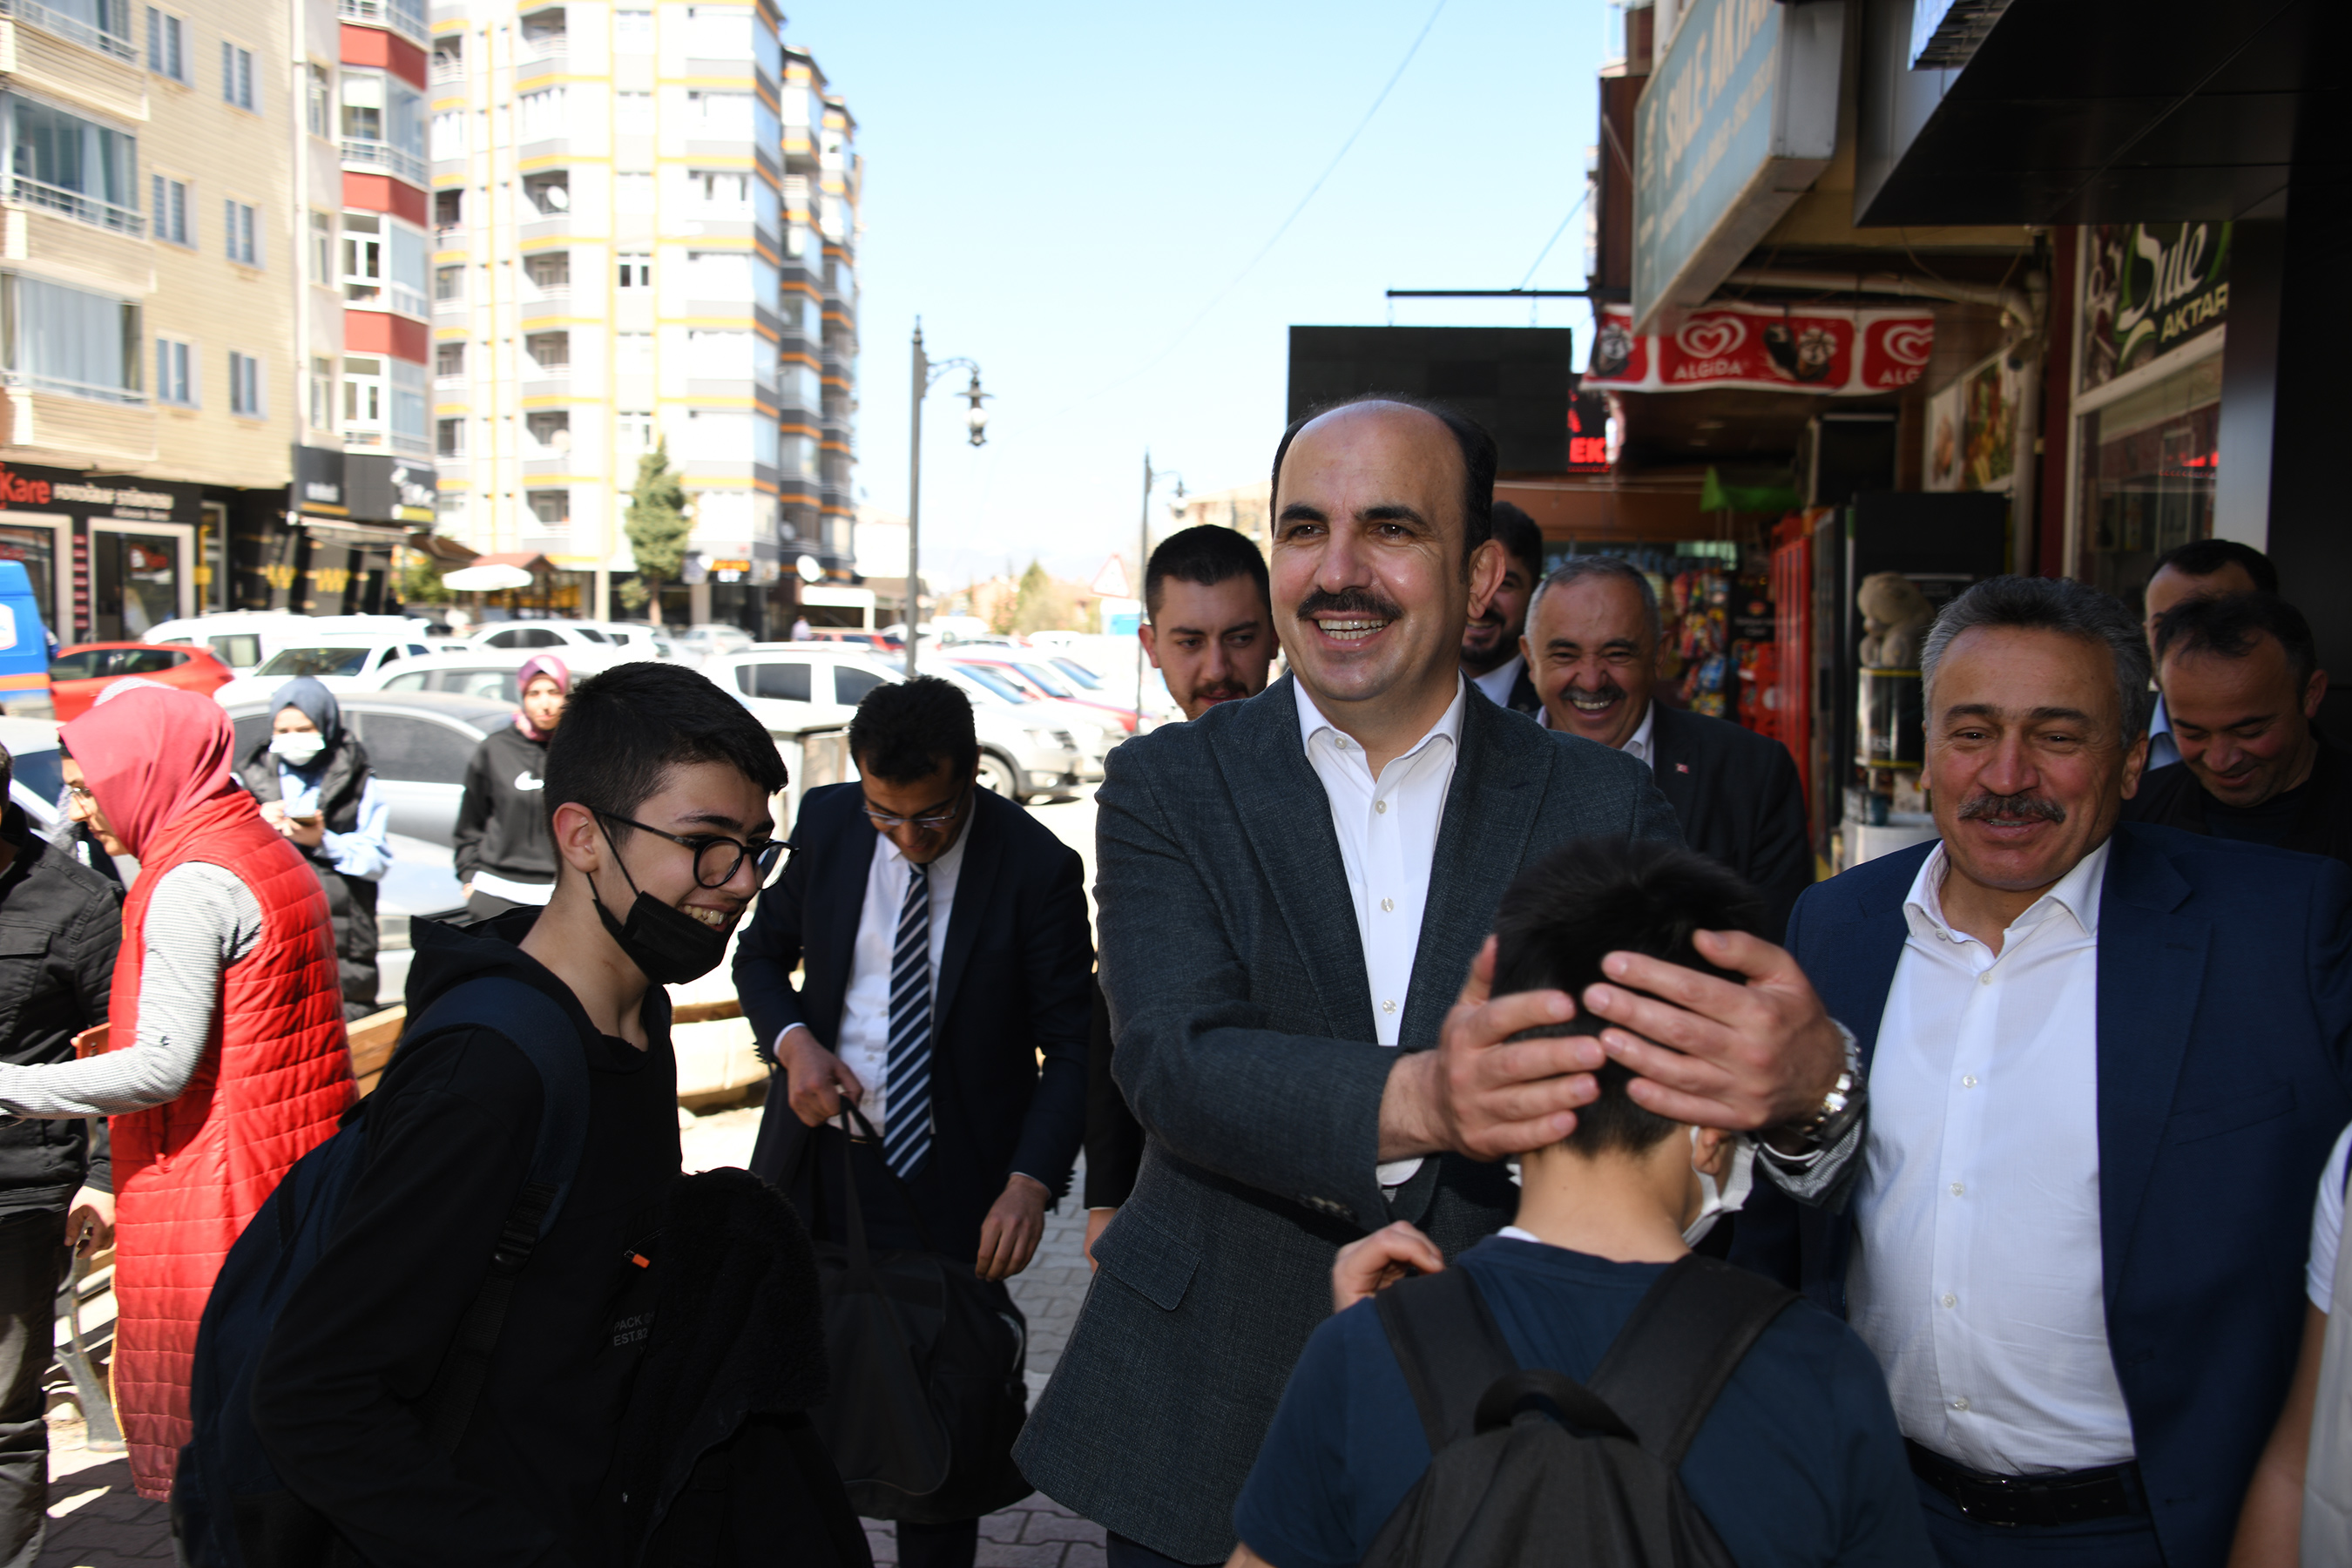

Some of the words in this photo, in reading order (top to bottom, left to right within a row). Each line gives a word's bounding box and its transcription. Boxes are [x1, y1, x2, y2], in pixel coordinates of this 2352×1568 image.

[1878, 366, 1921, 385] ALG
[0, 471, 51, 504] Kare
[613, 1314, 643, 1332] PACK
[613, 1328, 648, 1347] EST.82
